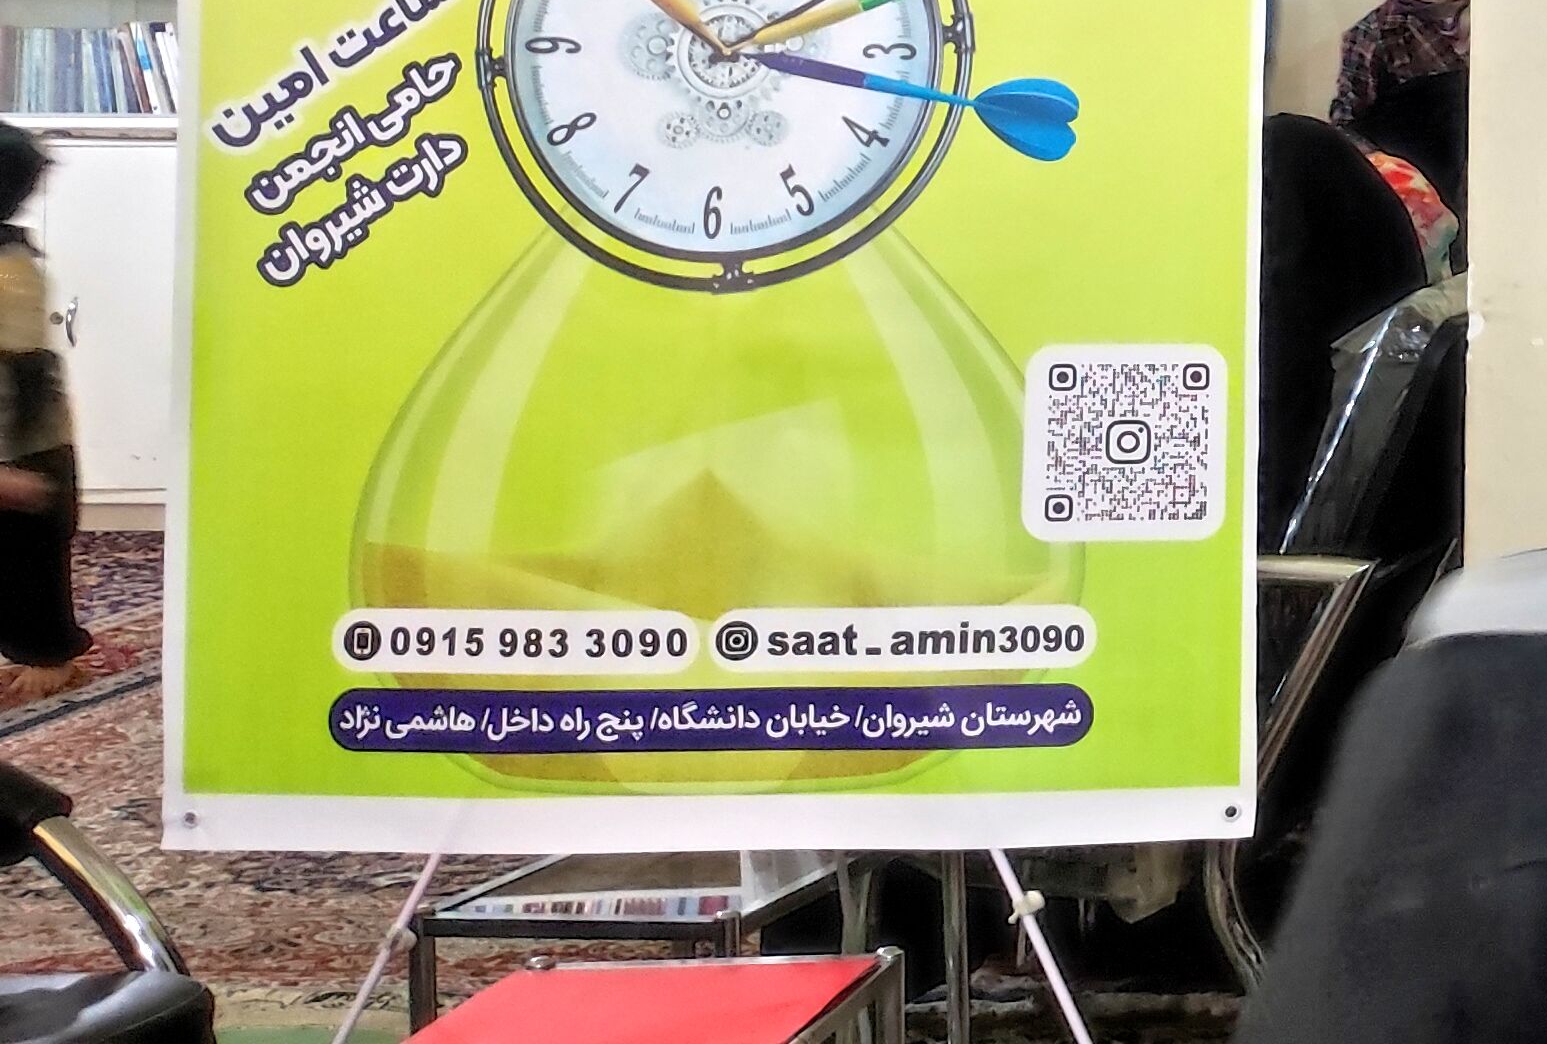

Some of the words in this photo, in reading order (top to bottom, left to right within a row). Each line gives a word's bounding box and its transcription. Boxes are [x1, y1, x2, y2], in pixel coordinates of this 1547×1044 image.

[525, 36, 582, 56] 9
[863, 41, 917, 61] 3
[212, 45, 330, 148] امین
[367, 59, 456, 142] حامی
[546, 112, 598, 147] 8
[842, 115, 890, 149] 4
[251, 111, 367, 210] انجمن
[386, 138, 463, 196] دارت
[613, 163, 650, 214] 7
[779, 164, 815, 217] 5
[264, 180, 386, 281] شیروان
[702, 186, 722, 240] 6
[390, 627, 484, 657] 0915
[499, 628, 569, 658] 983
[585, 628, 688, 658] 3090
[339, 703, 381, 740] نژاد
[385, 705, 476, 739] هاشمی
[560, 706, 590, 741] راه
[596, 707, 644, 742] پنج
[765, 704, 851, 738] خیابان
[961, 700, 1082, 737] شهرستان
